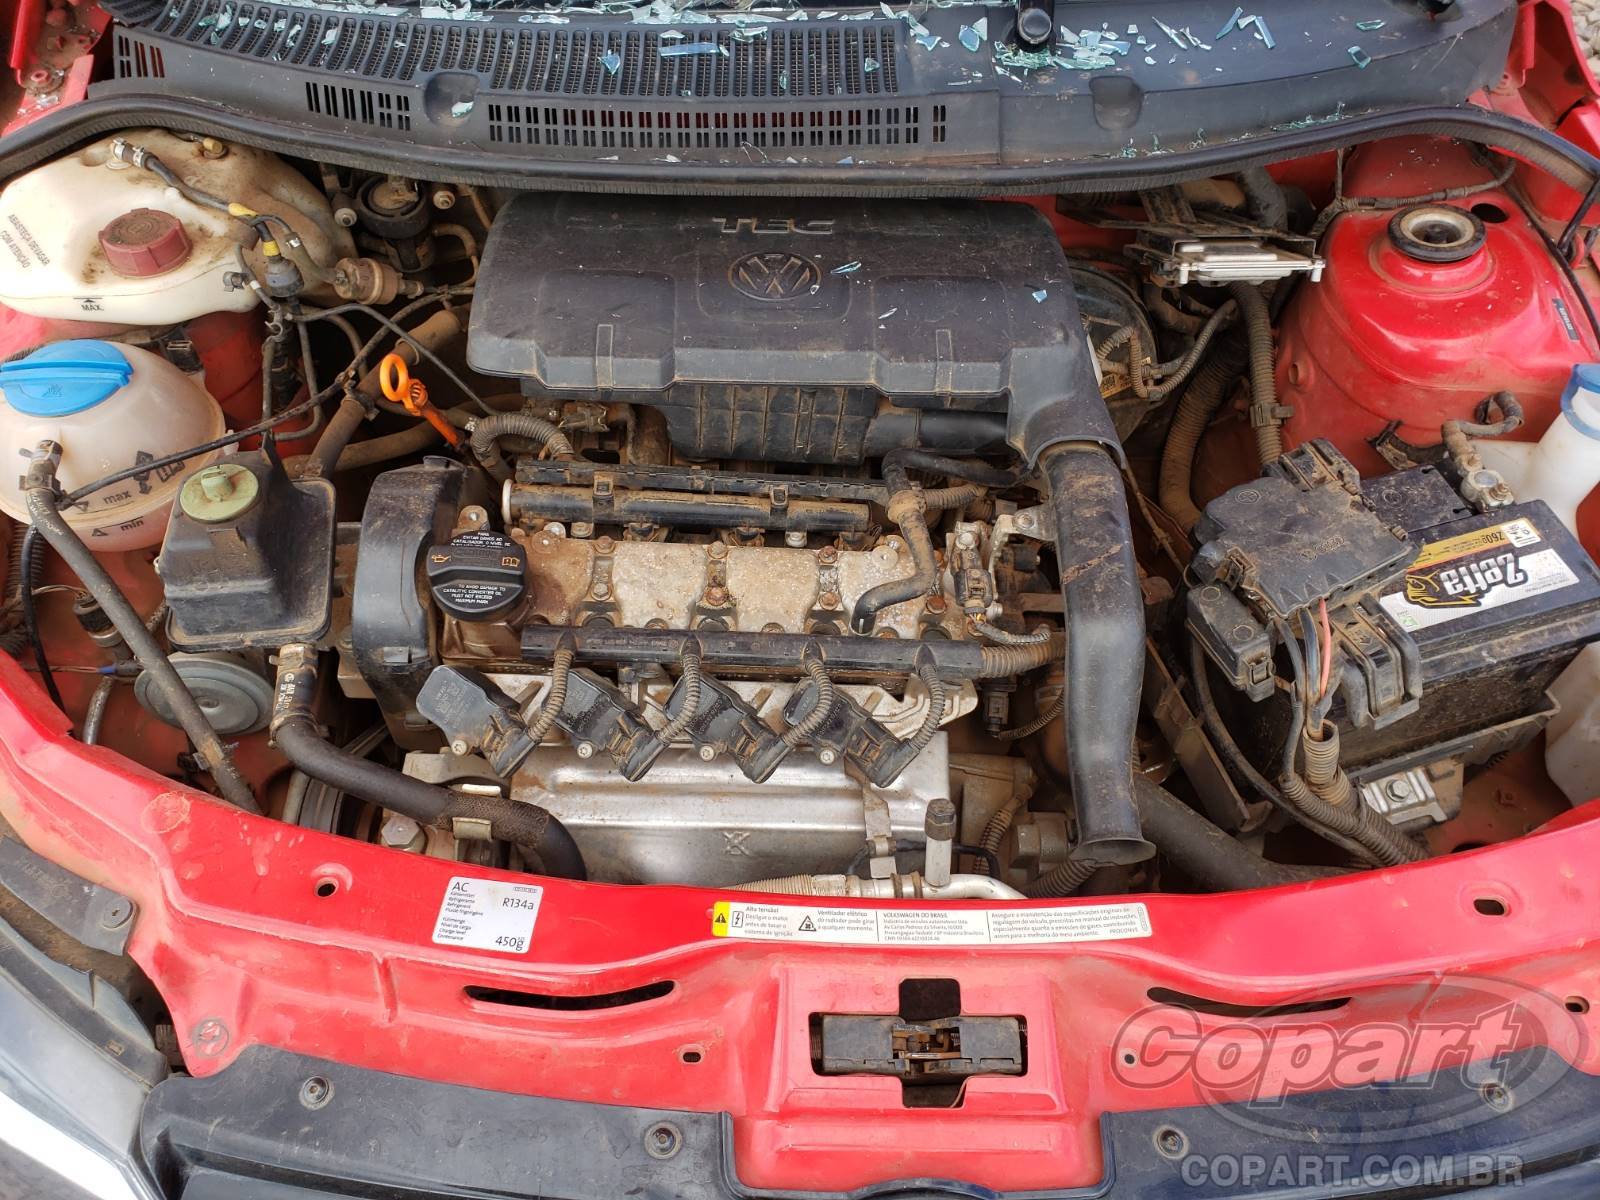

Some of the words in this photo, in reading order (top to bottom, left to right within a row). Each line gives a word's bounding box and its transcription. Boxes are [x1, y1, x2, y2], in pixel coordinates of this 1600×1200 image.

[0, 230, 13, 245] COM
[28, 240, 51, 266] DEVAGAR
[103, 490, 132, 504] max
[120, 520, 144, 531] min
[1439, 552, 1525, 596] Zetta
[452, 881, 469, 892] AC
[502, 897, 534, 910] R134a
[495, 935, 524, 951] 450g
